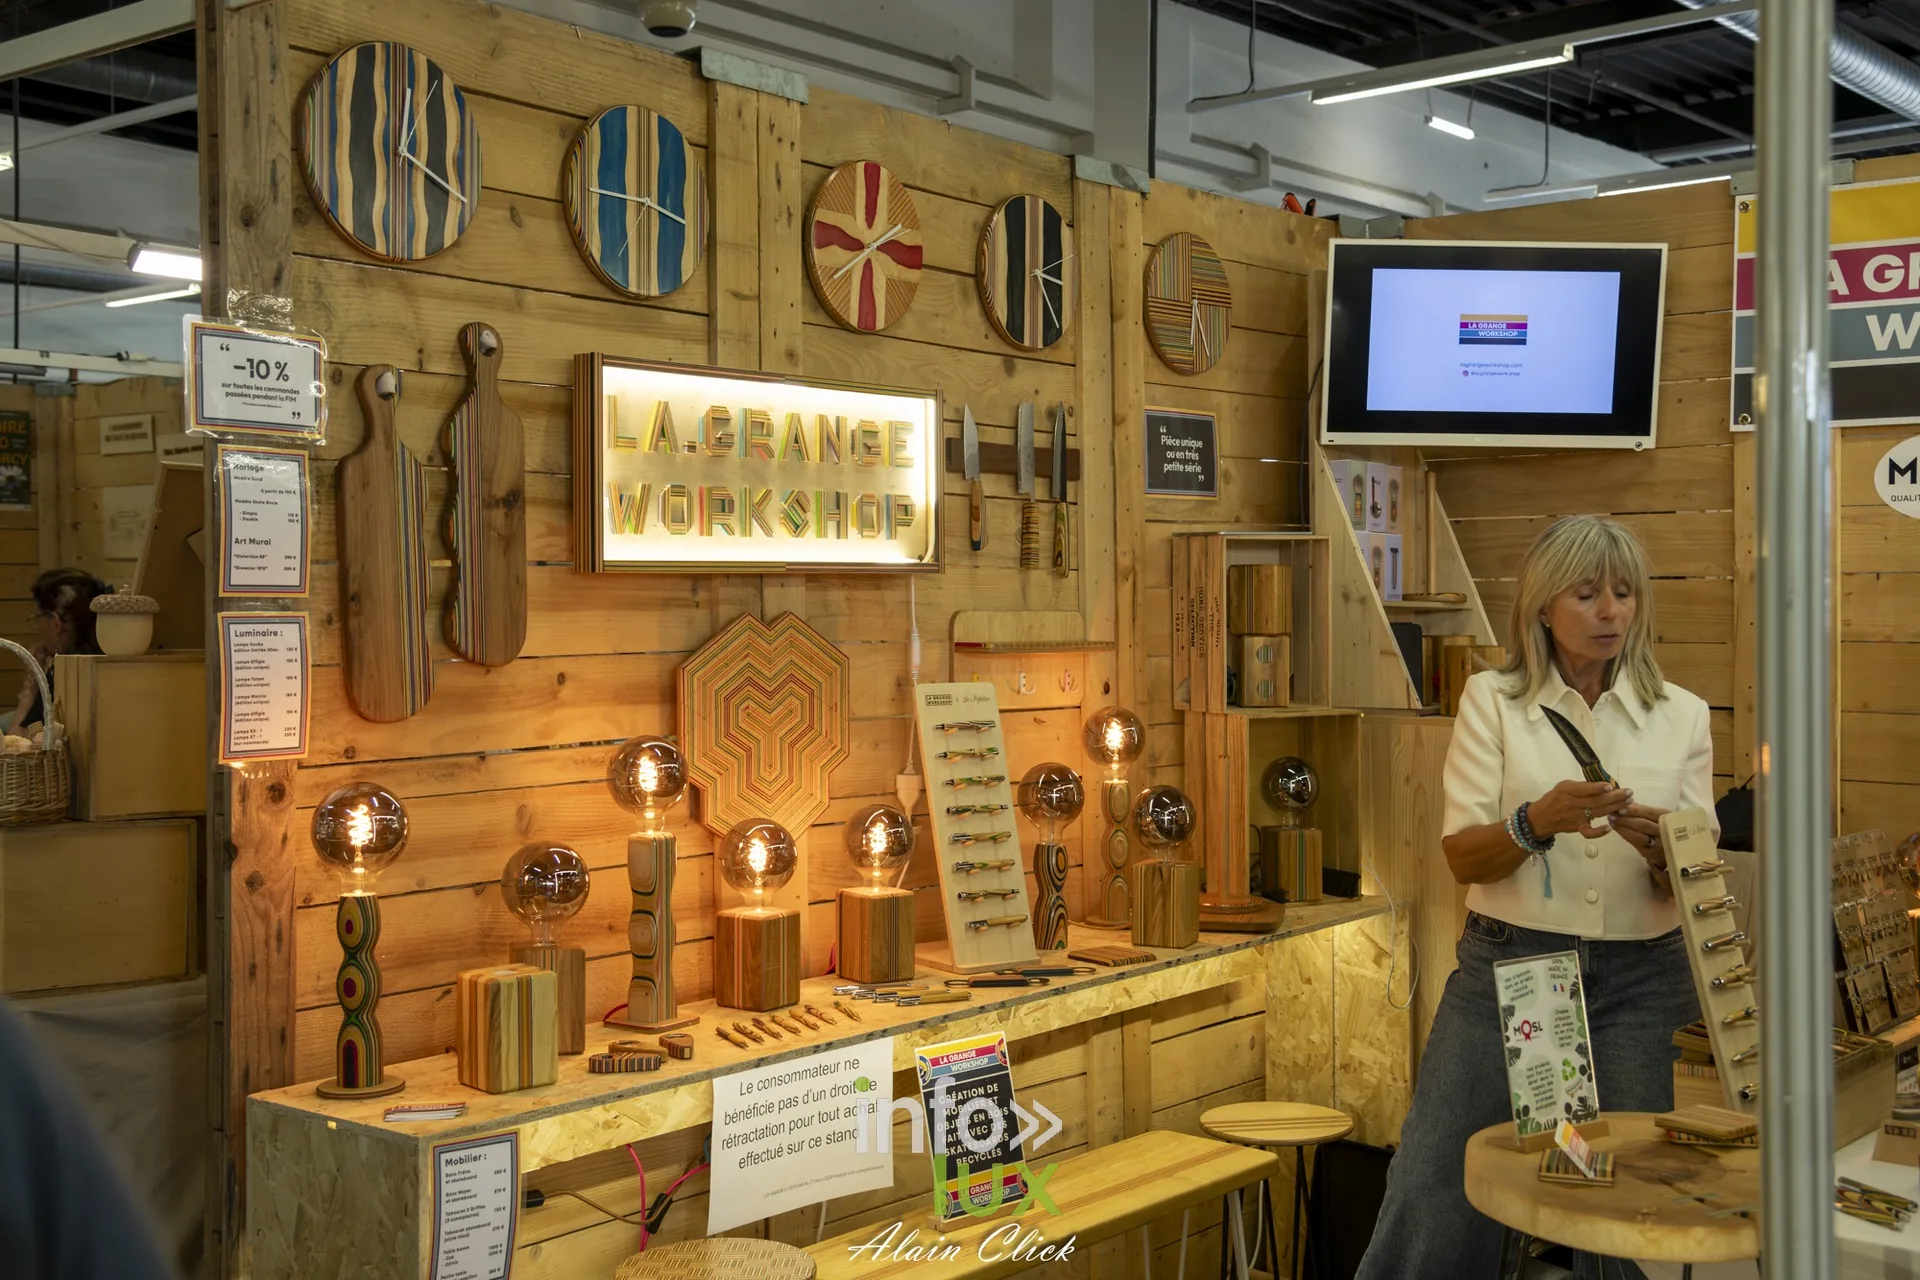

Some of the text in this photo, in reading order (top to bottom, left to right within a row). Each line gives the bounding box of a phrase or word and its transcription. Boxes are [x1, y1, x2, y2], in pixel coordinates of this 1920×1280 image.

[225, 391, 251, 399] passées
[233, 382, 253, 390] toutes
[264, 386, 300, 395] commandes
[1161, 435, 1203, 449] Pièce unique
[1166, 450, 1199, 460] ou en très
[1163, 462, 1202, 473] petite série
[606, 480, 916, 540] WORKSHOP
[234, 629, 278, 637] Luminaire
[949, 1050, 976, 1063] GRANGE
[951, 1058, 988, 1072] WORKSHOP
[740, 1058, 860, 1096] Le consommateur ne
[939, 1084, 999, 1104] CRÉATION DE
[724, 1100, 775, 1126] bénéficie
[778, 1096, 799, 1114] pas
[830, 1081, 856, 1099] droit
[860, 1077, 877, 1092] de
[943, 1096, 998, 1117] MOBILIER ET
[936, 1107, 1008, 1132] OBJETS EN BOIS
[722, 1123, 785, 1150] rétractation
[788, 1114, 814, 1135] pour
[818, 1108, 839, 1124] tout
[943, 1120, 1007, 1144] FAIT AVEC DES
[945, 1133, 1009, 1156] SKATEBOARDS
[738, 1144, 784, 1169] effectué
[787, 1140, 805, 1155] sur
[808, 1136, 823, 1149] ce
[445, 1154, 482, 1167] Mobilier
[452, 1174, 477, 1183] skateboard
[452, 1194, 477, 1202] skateboard
[445, 1228, 464, 1236] Tabouret
